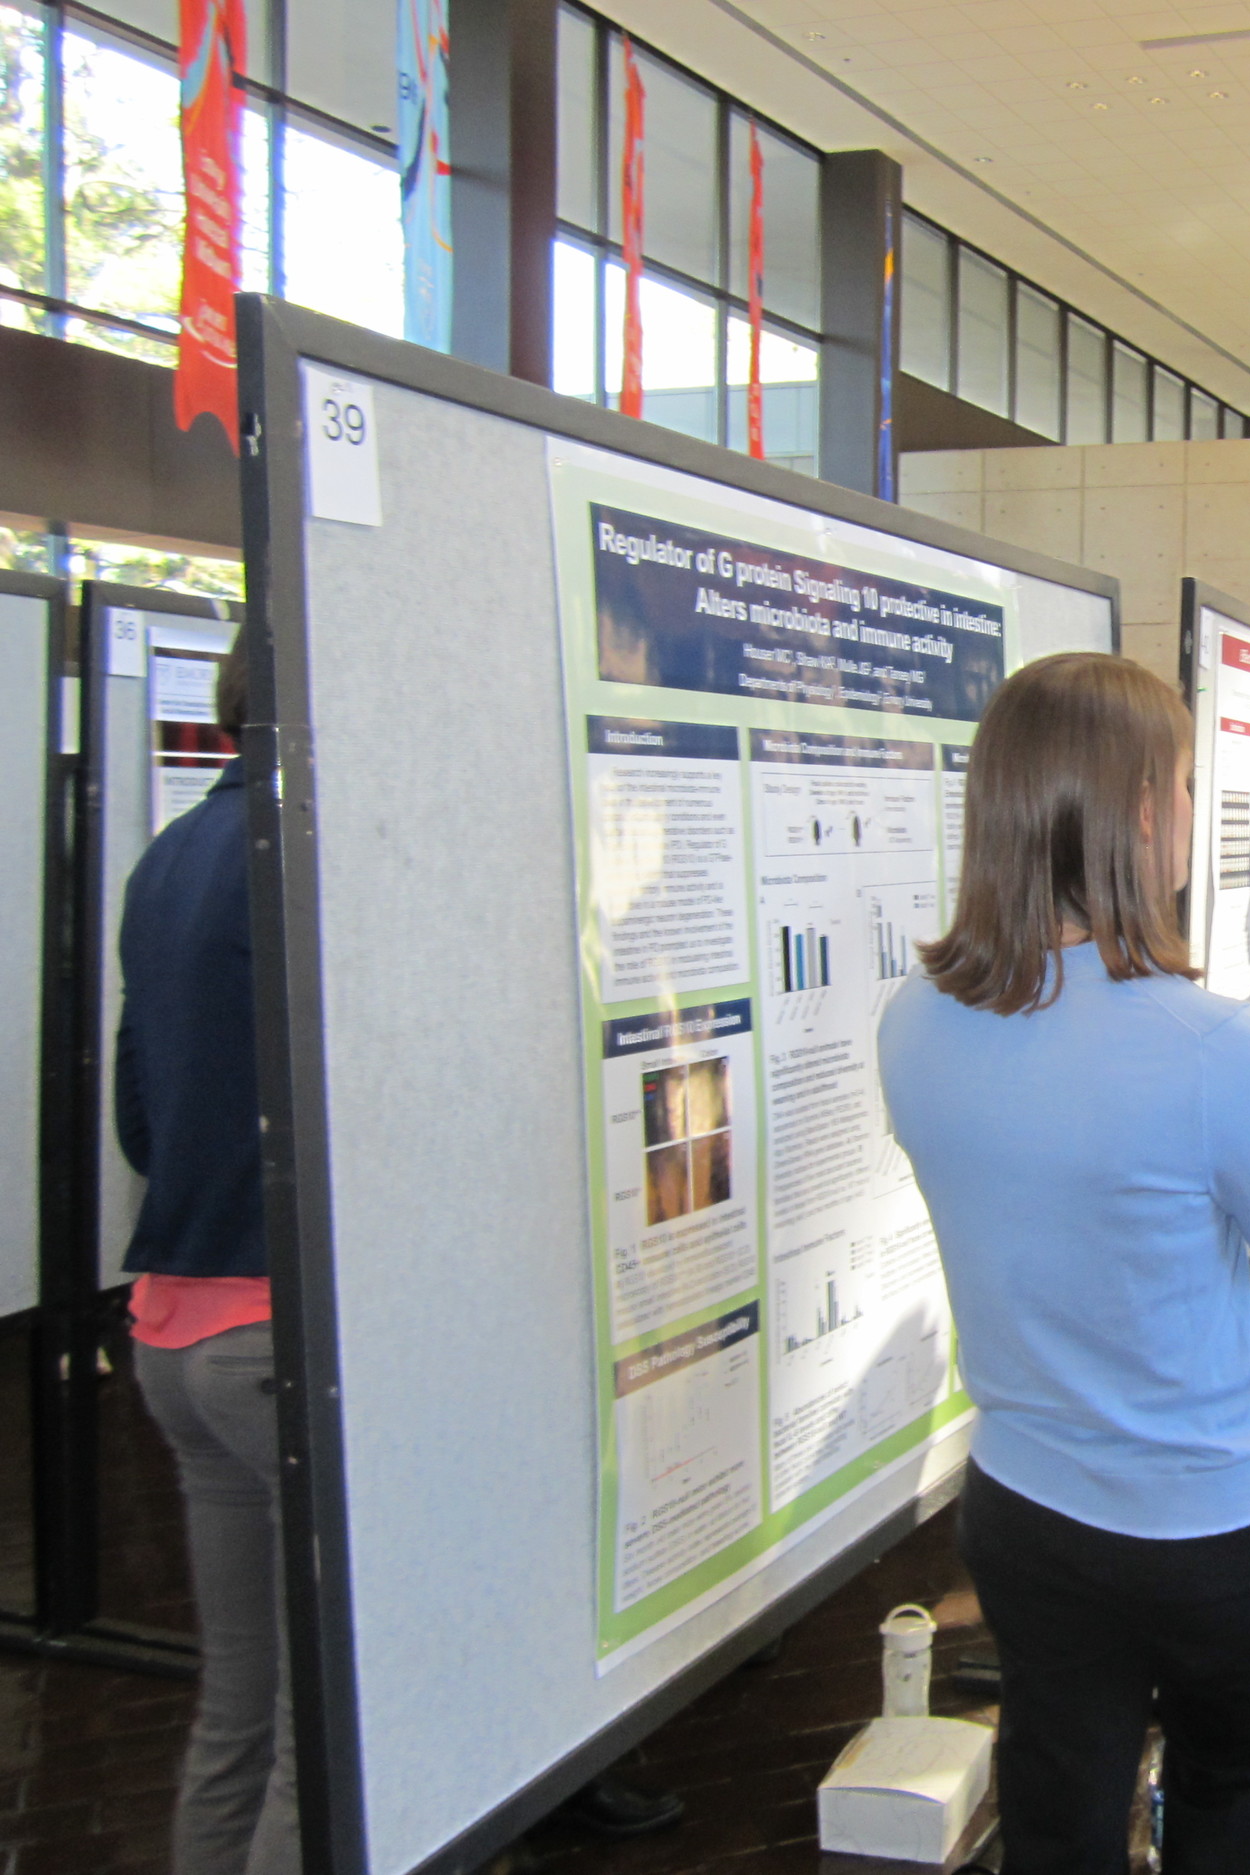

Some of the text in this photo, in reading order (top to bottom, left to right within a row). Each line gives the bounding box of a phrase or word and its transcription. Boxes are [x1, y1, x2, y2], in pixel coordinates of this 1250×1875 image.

[322, 398, 367, 446] 39
[598, 522, 1001, 637] Regulator of G protein Signaling 10 protective in intestine:
[114, 620, 137, 641] 36
[695, 587, 953, 663] Alters microbiota and immune activity
[605, 729, 664, 746] Introduction
[618, 1027, 662, 1046] Intestinal
[627, 1358, 649, 1380] DSS
[651, 1343, 696, 1369] Pathology
